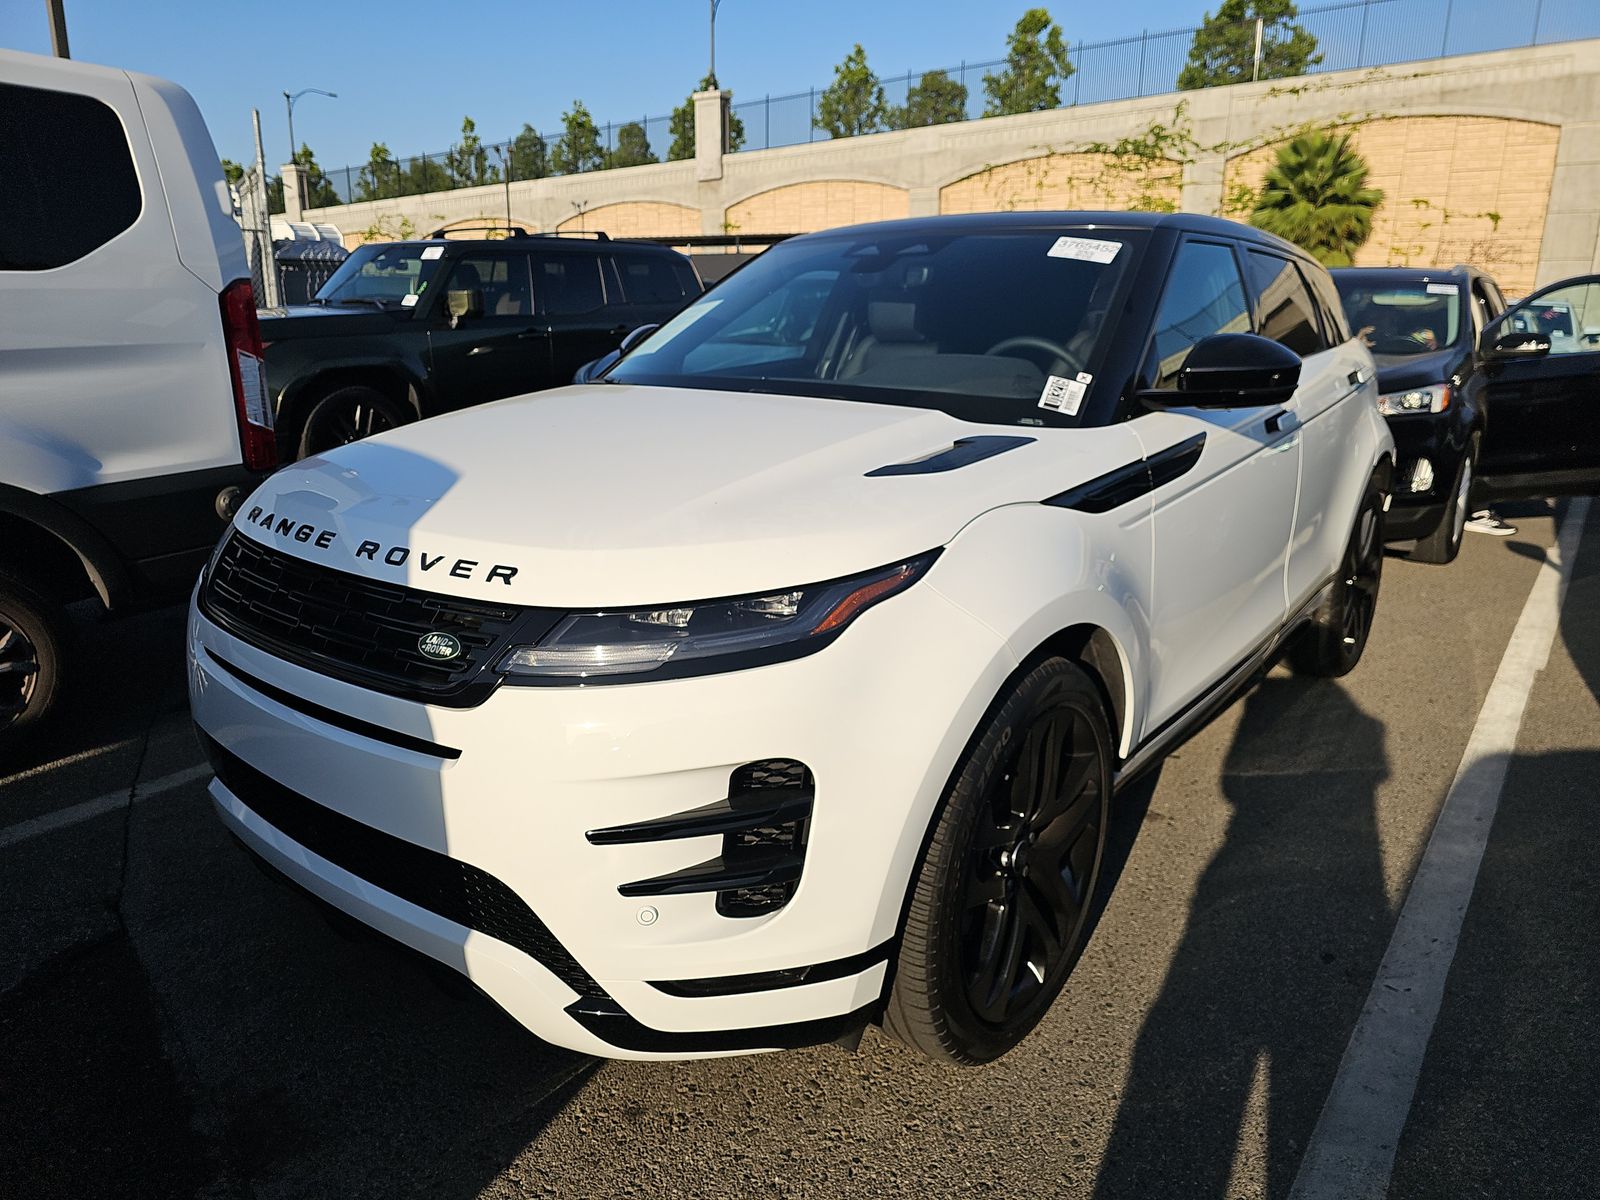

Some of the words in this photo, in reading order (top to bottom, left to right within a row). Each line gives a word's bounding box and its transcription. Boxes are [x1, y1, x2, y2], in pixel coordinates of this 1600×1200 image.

[247, 505, 337, 549] RANGE
[355, 540, 519, 585] ROVER
[425, 635, 449, 646] LAND
[424, 643, 453, 656] ROVER
